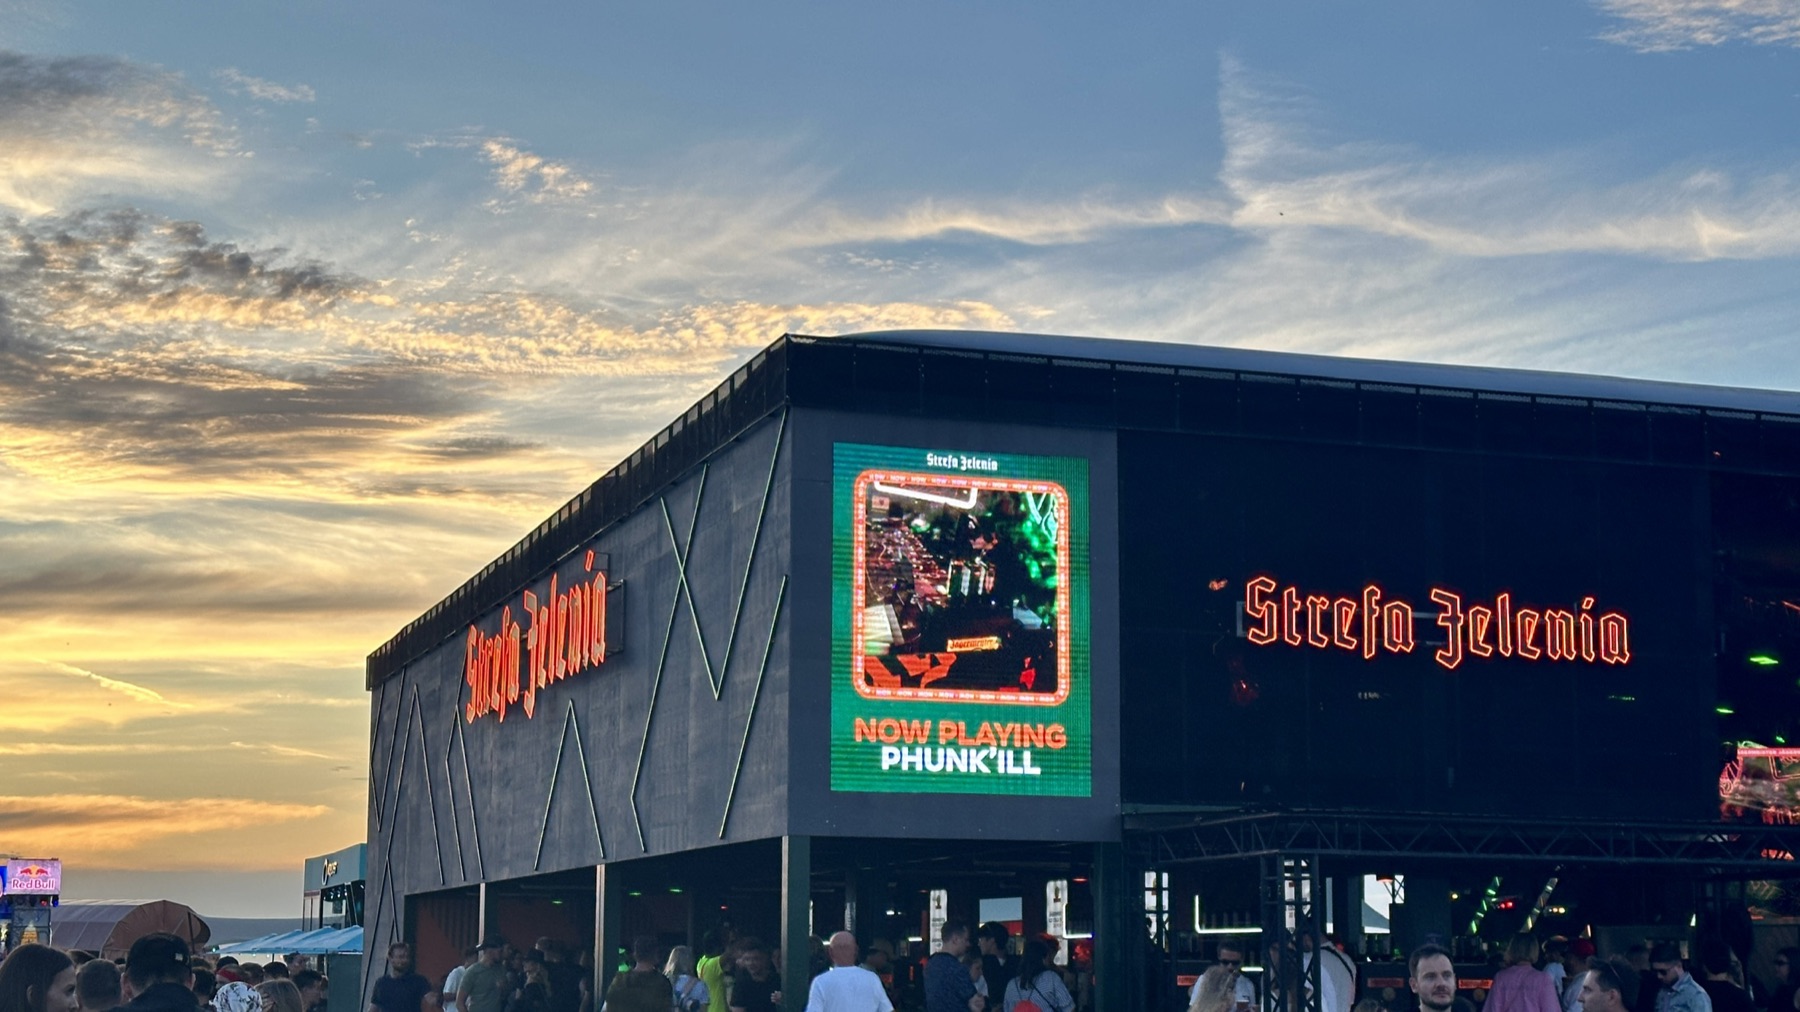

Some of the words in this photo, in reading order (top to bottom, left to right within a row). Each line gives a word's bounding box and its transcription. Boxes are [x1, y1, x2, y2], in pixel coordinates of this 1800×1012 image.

[927, 452, 958, 469] Strefa
[960, 455, 998, 471] Jelenia
[466, 604, 520, 724] Strefa
[523, 550, 606, 719] Jelenia
[1246, 575, 1415, 660] Strefa
[1431, 586, 1630, 670] Jelenia
[854, 717, 931, 743] NOW
[939, 721, 1067, 749] PLAYING
[12, 879, 33, 889] Red
[34, 879, 55, 889] Bull
